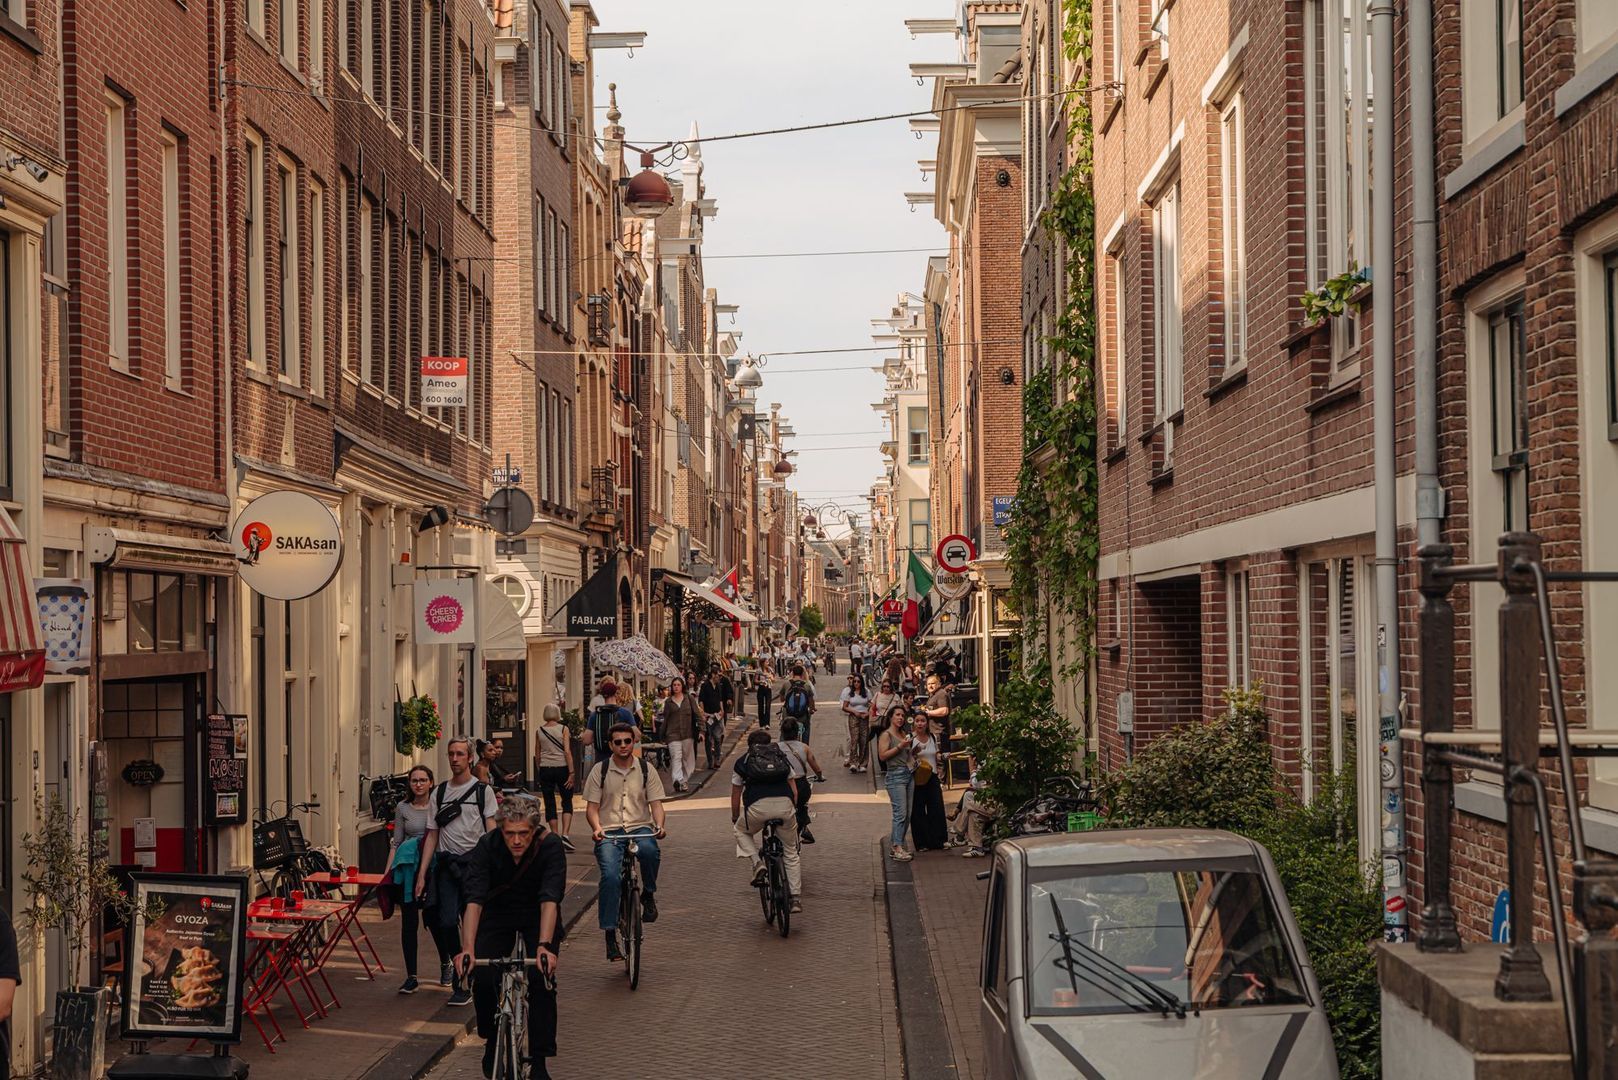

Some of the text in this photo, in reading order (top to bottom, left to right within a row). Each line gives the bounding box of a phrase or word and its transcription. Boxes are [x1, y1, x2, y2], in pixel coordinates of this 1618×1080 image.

[427, 361, 460, 370] KOOP
[427, 378, 457, 387] Ameo
[276, 536, 337, 550] SAKAsan
[430, 606, 459, 616] CHEESY
[432, 614, 458, 624] CAKES
[571, 615, 615, 625] FABI.ART
[131, 770, 154, 780] OPEN
[175, 914, 209, 925] GYOZA
